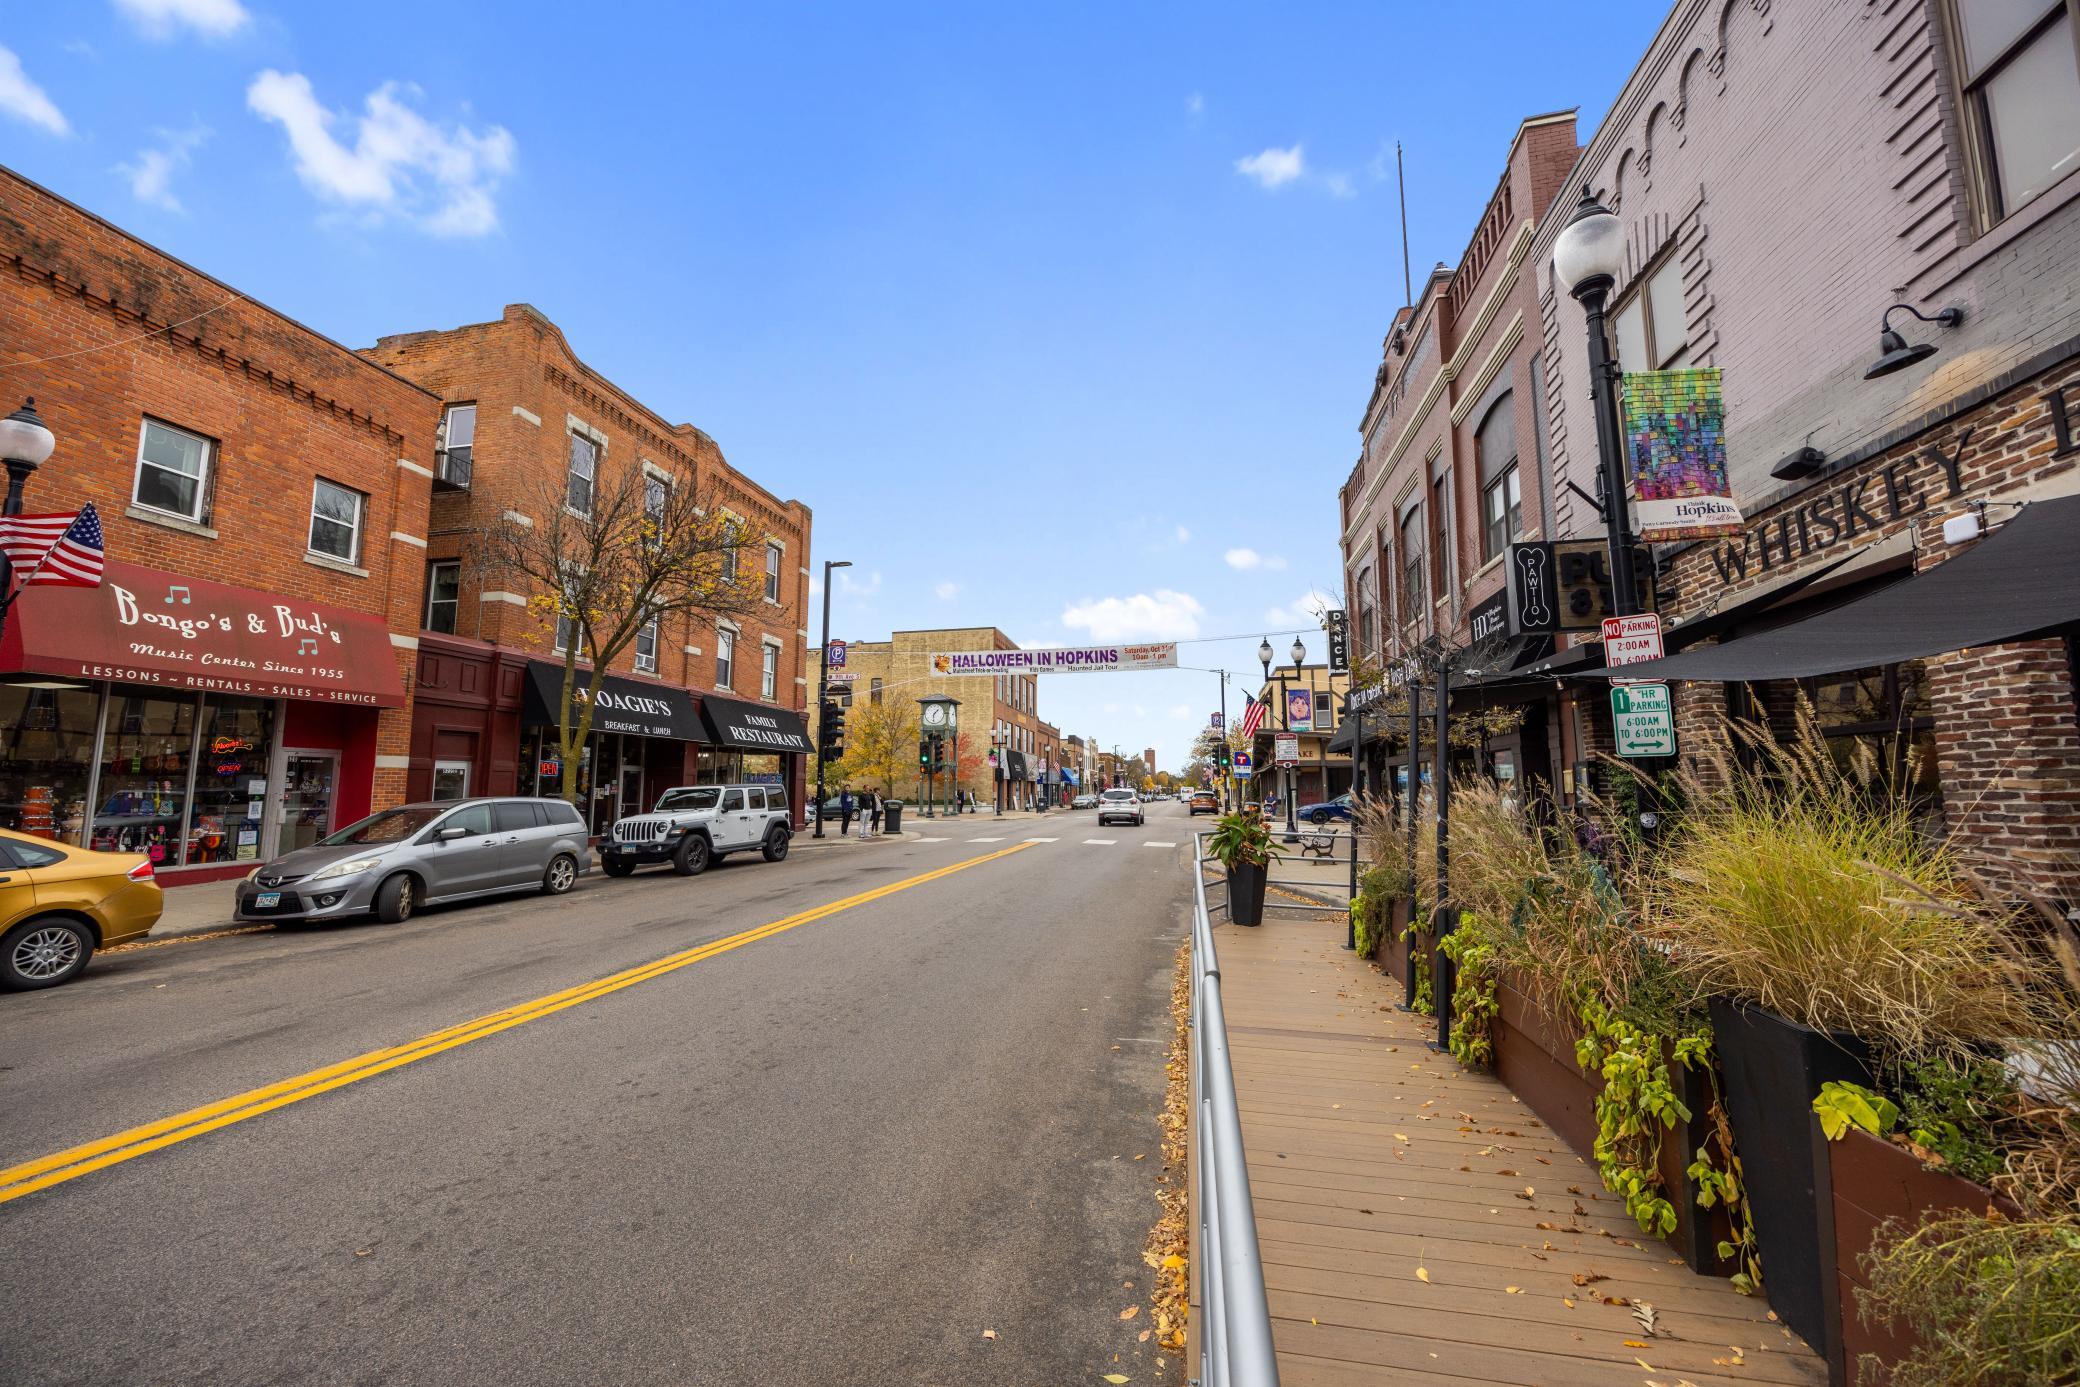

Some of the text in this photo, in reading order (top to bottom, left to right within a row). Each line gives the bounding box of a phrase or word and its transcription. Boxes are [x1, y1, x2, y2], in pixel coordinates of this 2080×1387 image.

[1676, 502, 1736, 518] Hopkins
[1711, 426, 1976, 585] WHISKEY
[1527, 558, 1540, 615] PAWTIO
[110, 583, 342, 644] Bongo's & Bud's
[1604, 620, 1656, 637] NO PARKING
[1333, 612, 1344, 666] DANCE
[130, 642, 344, 679] Music Center Since 1955
[952, 649, 1118, 668] HALLOWEEN IN HOPKINS
[1612, 657, 1621, 667] TO
[81, 665, 377, 704] LESSONS RENTALS SALES SERVICE
[1617, 692, 1667, 711] 1 PARKING
[1641, 690, 1656, 699] HR
[604, 720, 672, 736] BREAKFAST & LUNCH
[744, 714, 778, 728] FAMILY
[729, 725, 805, 748] RESTAURANT
[1620, 729, 1630, 739] TO
[217, 763, 241, 773] OPEN
